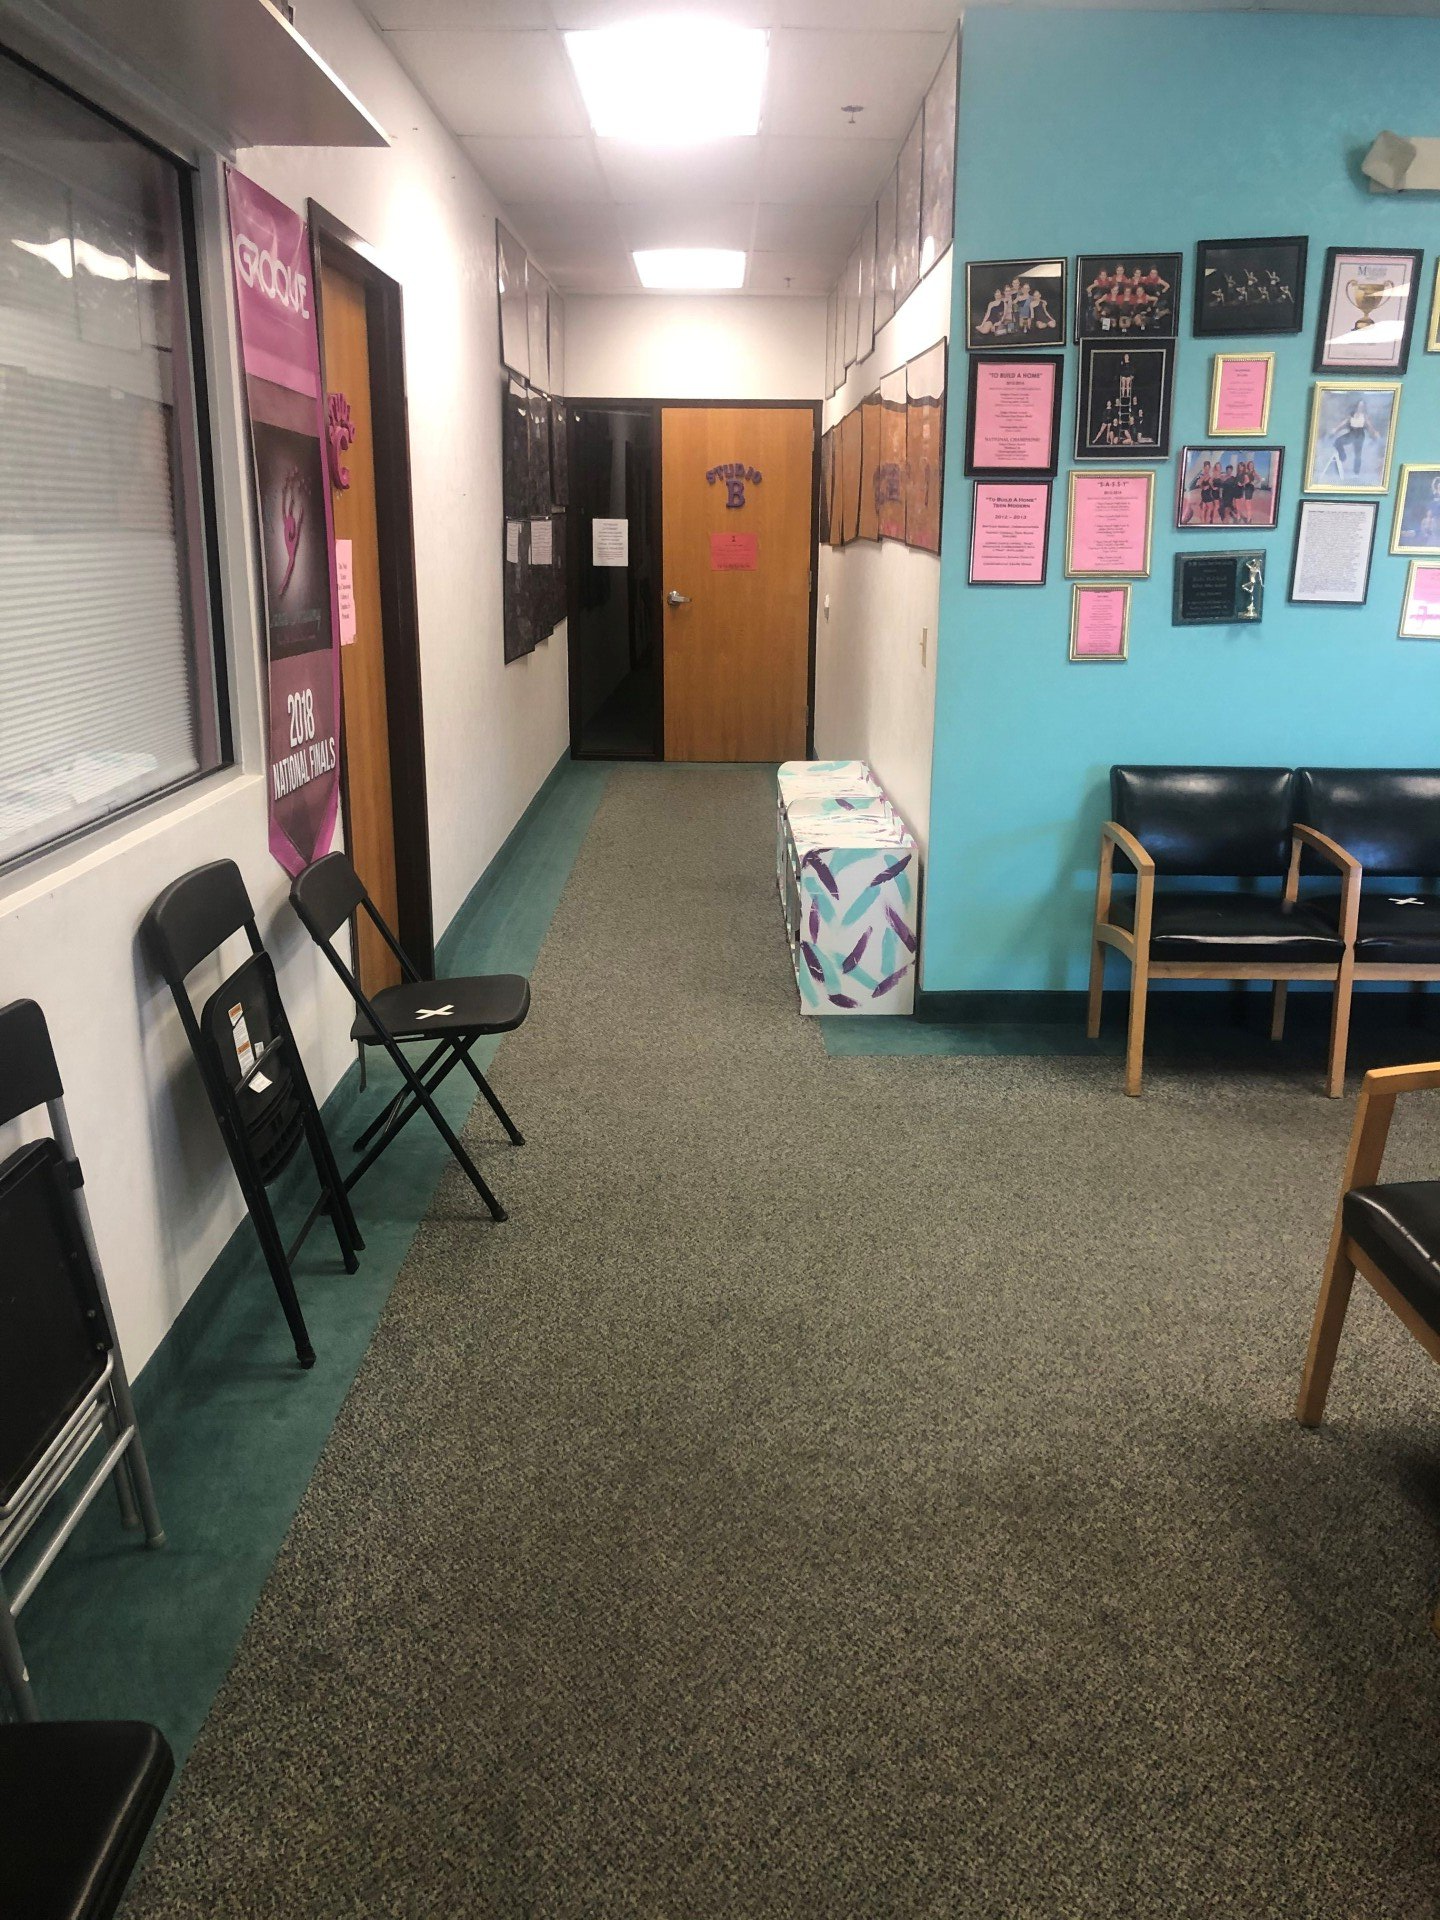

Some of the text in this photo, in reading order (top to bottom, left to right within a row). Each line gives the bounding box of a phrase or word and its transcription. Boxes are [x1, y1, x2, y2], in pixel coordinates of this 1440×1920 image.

[726, 480, 746, 509] B
[287, 688, 316, 749] 2018
[273, 737, 337, 801] NATIONAL FINALS
